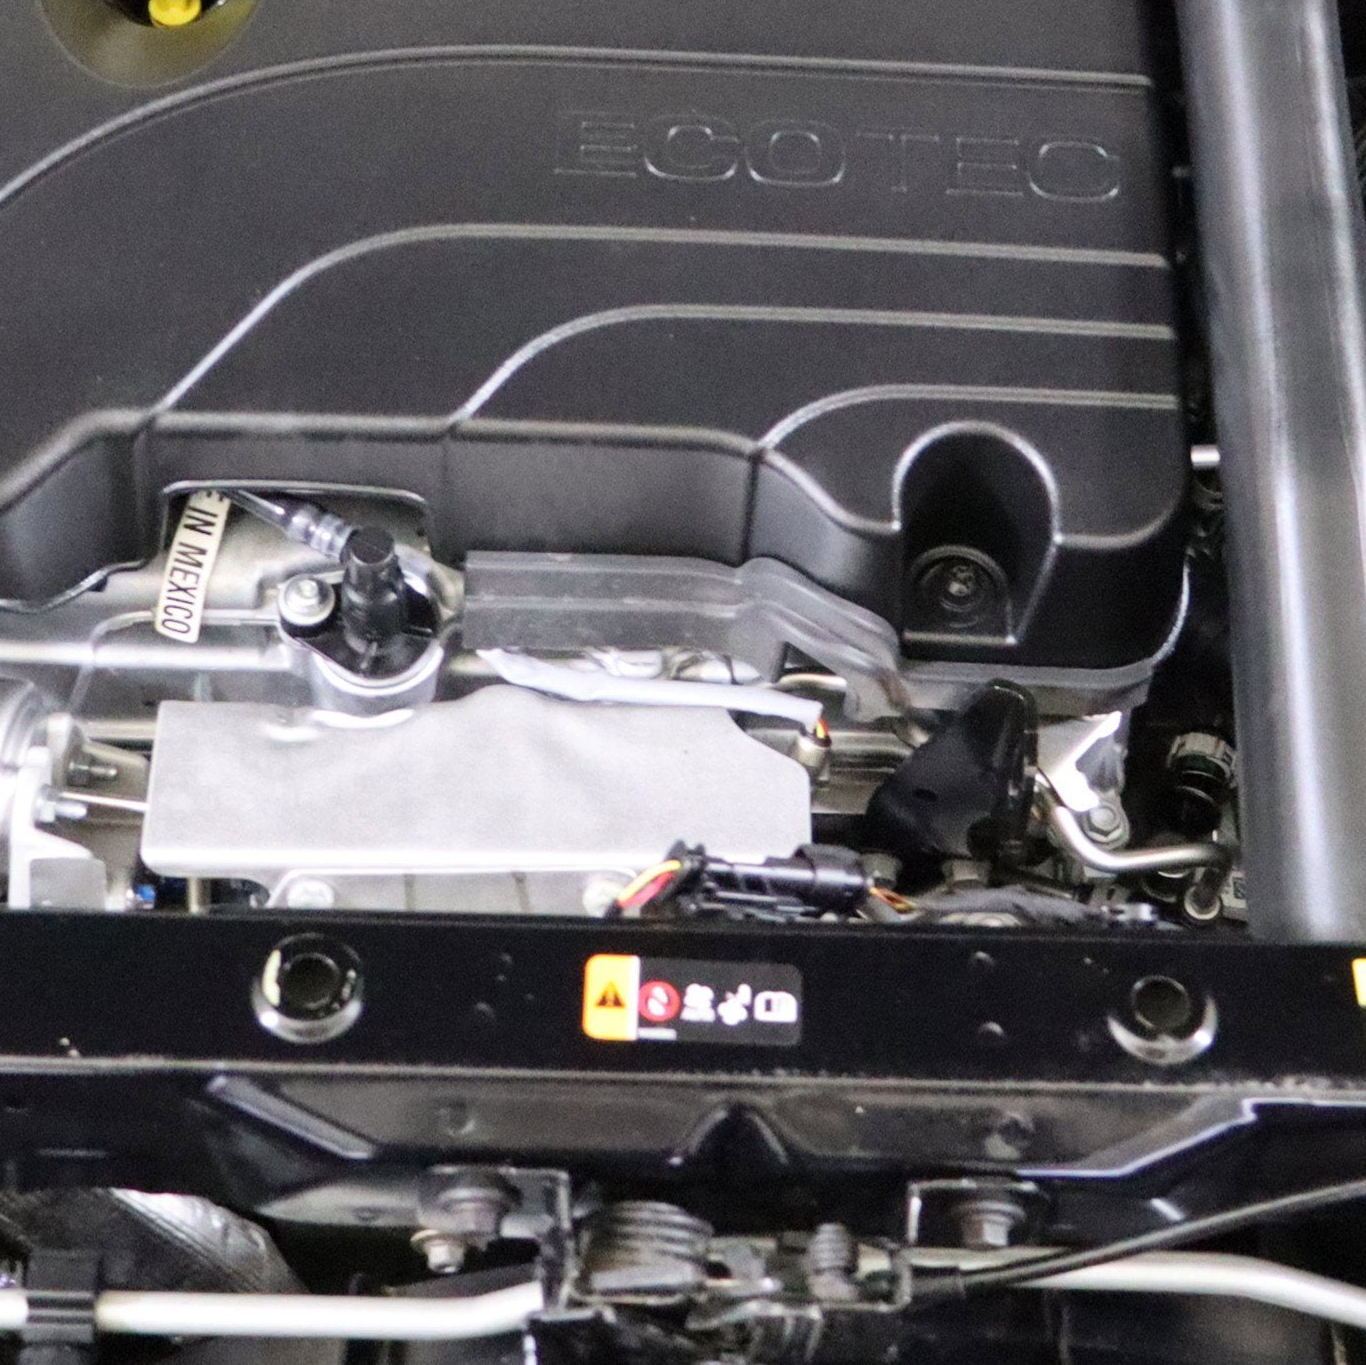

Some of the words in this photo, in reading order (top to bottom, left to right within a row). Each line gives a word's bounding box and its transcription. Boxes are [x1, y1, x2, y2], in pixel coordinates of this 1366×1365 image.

[553, 109, 1121, 204] ECOTEC
[183, 505, 218, 536] IN
[161, 542, 208, 634] MEXICO
